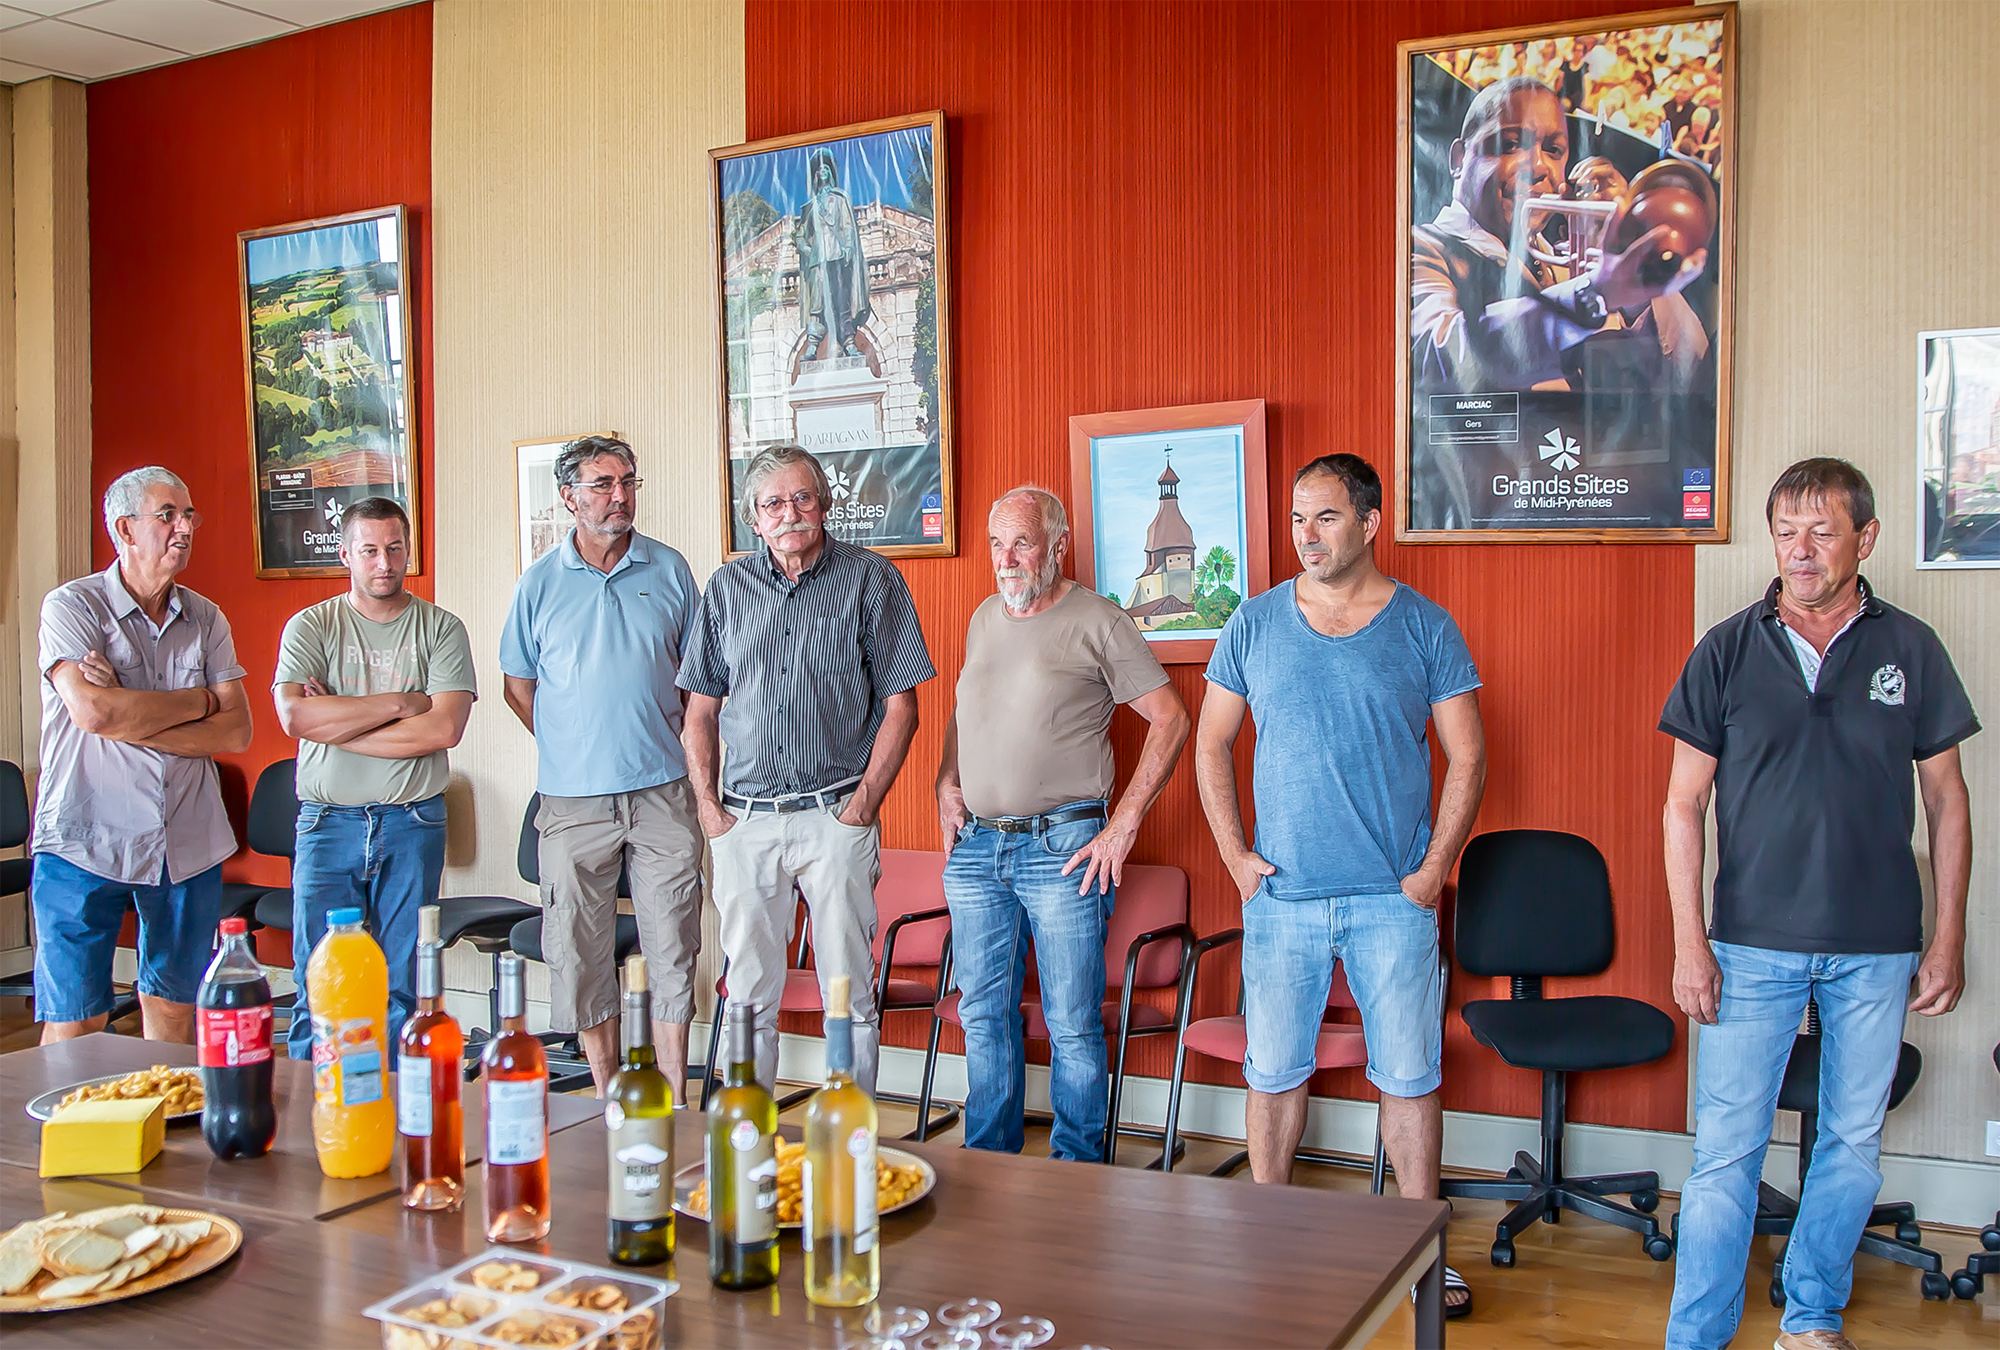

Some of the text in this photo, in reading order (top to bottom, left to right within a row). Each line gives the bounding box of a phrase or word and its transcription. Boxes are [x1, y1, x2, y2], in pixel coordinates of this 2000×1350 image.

[1456, 400, 1492, 409] MARCIAC
[1465, 419, 1482, 428] Gers
[1492, 474, 1629, 495] Grands Sites
[846, 501, 885, 518] Sites
[1513, 496, 1613, 511] de Midi-Pyrénées
[303, 530, 342, 545] Grands
